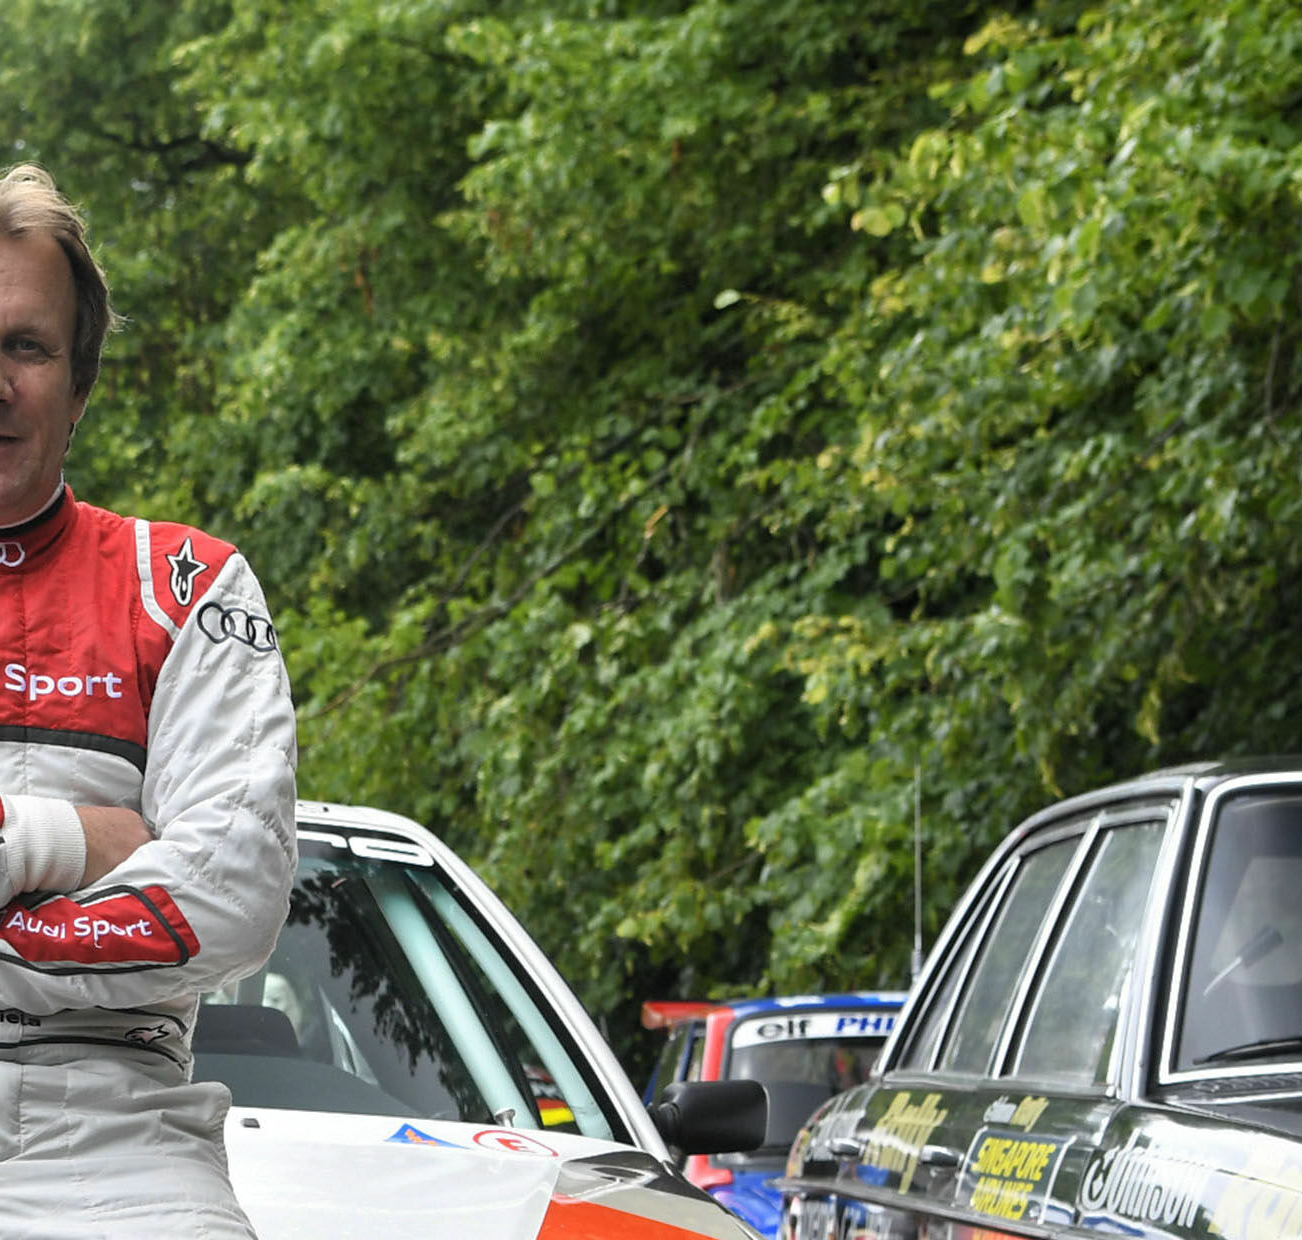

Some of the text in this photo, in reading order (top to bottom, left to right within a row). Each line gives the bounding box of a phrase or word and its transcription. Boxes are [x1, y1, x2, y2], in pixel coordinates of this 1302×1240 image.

[4, 663, 123, 701] Sport
[6, 911, 153, 948] Audi Sport
[757, 1019, 810, 1039] elf
[835, 1016, 895, 1033] PHI
